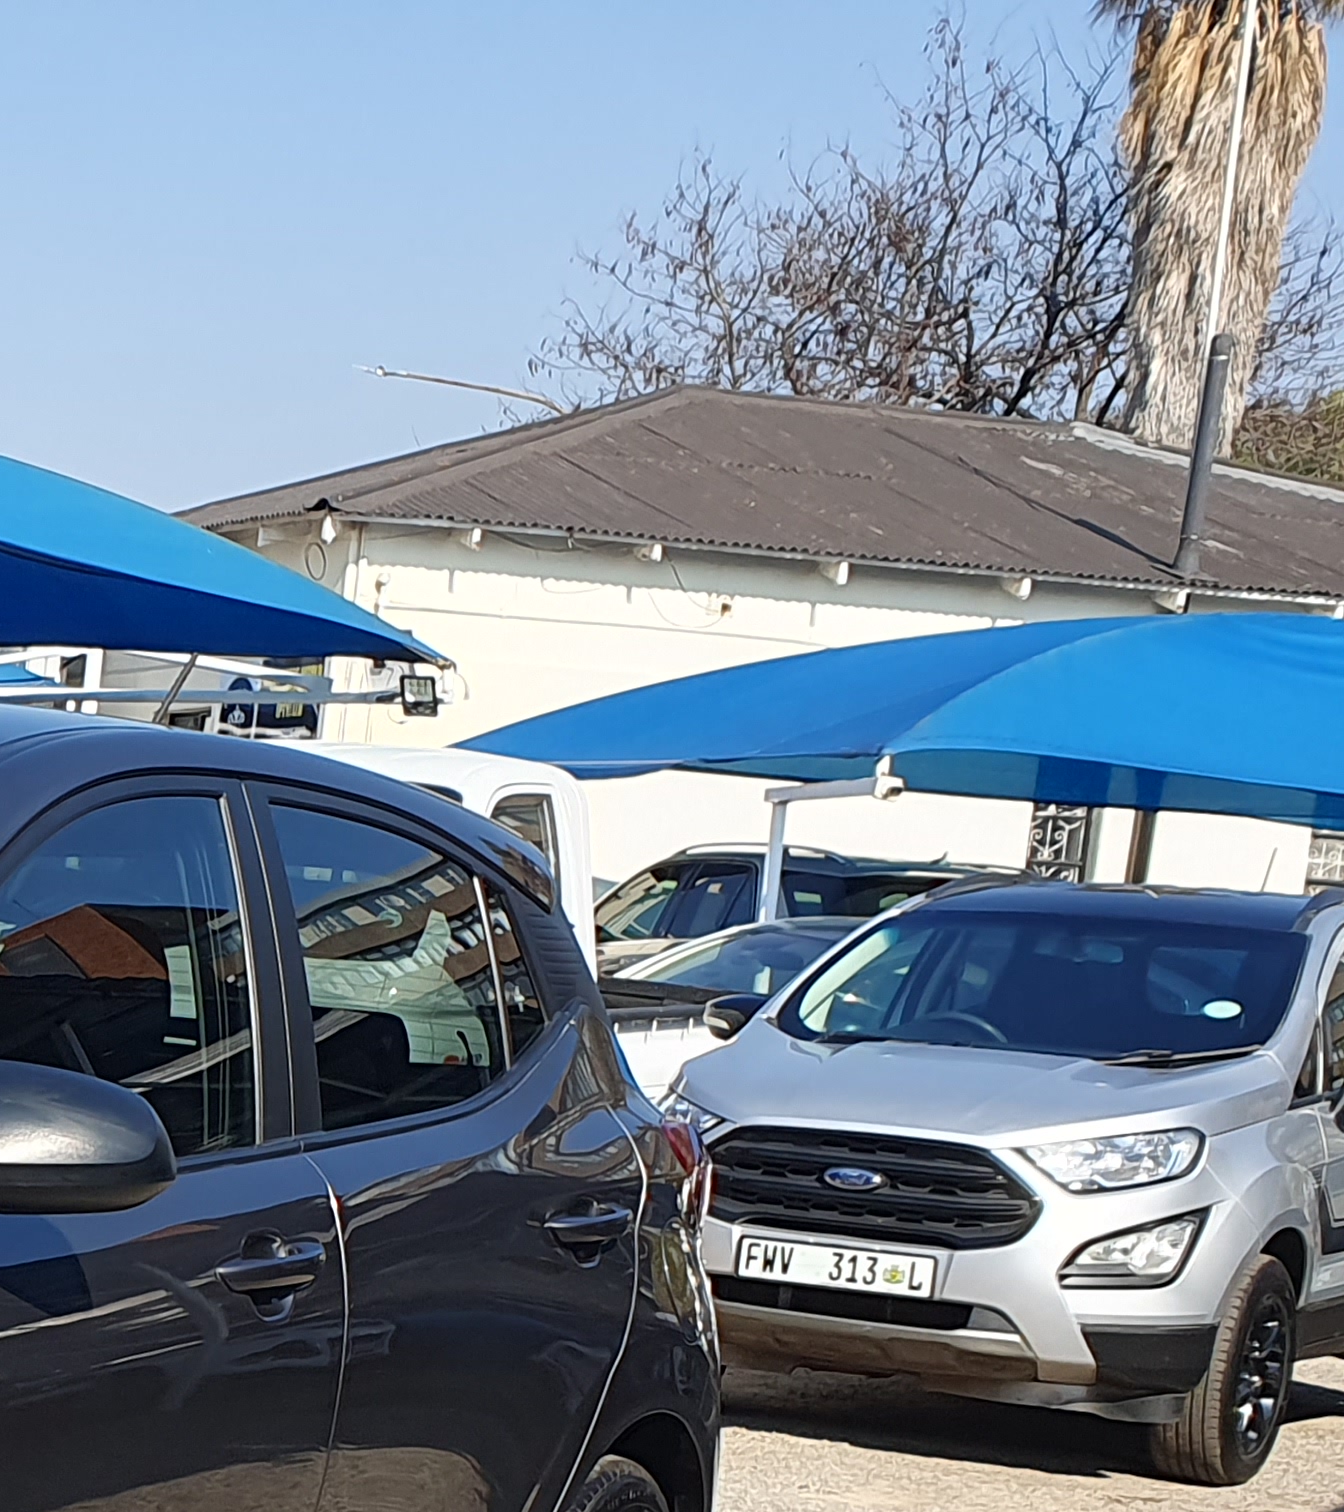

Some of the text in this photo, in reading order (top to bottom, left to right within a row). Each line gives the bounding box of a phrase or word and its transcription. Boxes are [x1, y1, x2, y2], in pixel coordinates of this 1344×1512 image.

[745, 1242, 923, 1291] FWV 313 L
